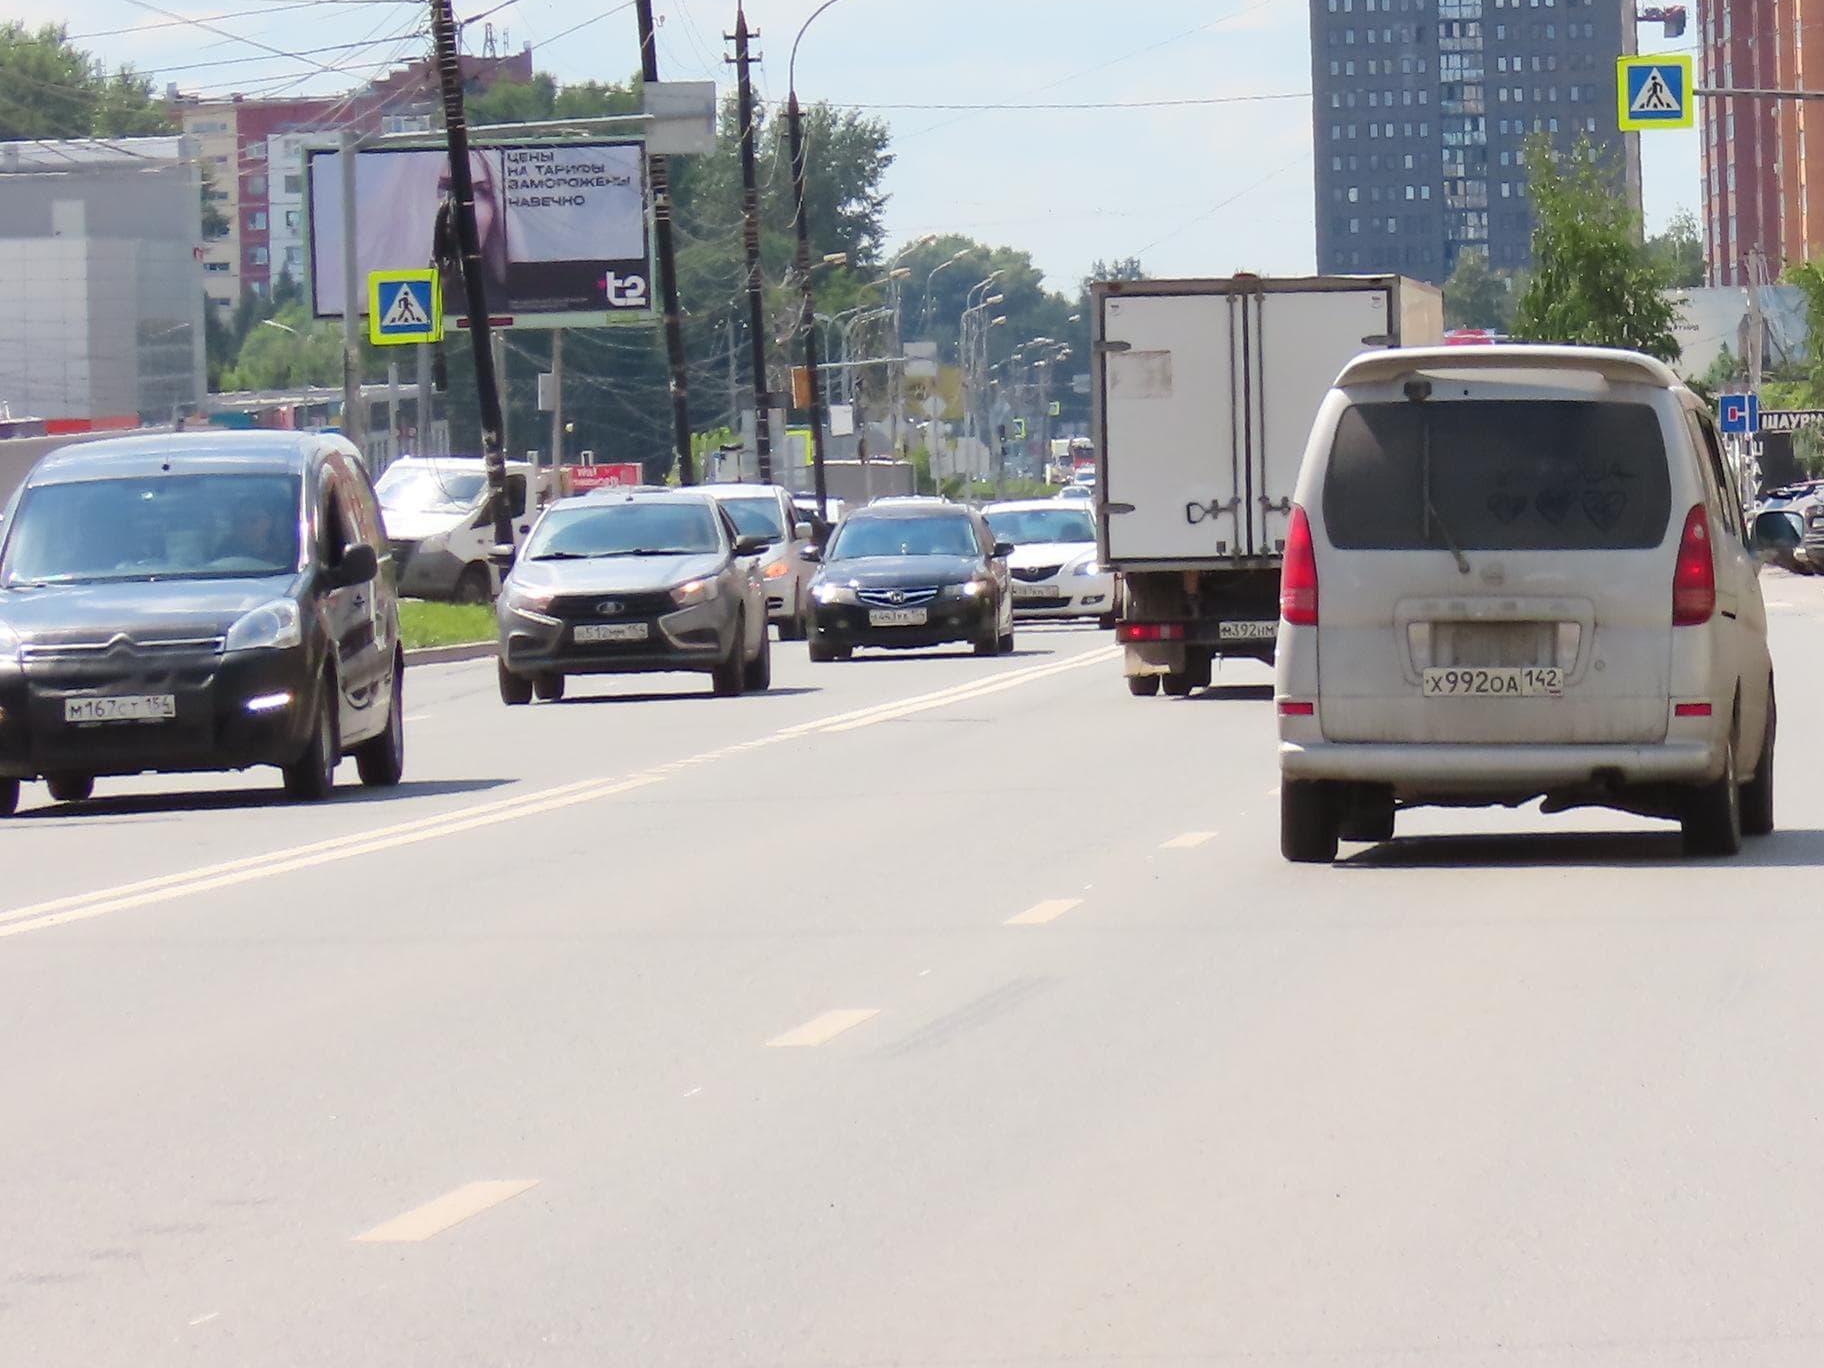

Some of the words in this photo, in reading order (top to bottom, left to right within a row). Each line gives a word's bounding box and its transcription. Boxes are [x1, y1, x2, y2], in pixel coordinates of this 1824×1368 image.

[507, 152, 555, 164] ЦЕНЫ
[507, 165, 528, 177] НА
[535, 164, 606, 175] ТАРИФЫ
[507, 176, 631, 190] ЗАМОРОЖЕНЫ
[508, 195, 586, 208] НАВЕЧНО
[606, 270, 647, 307] t2
